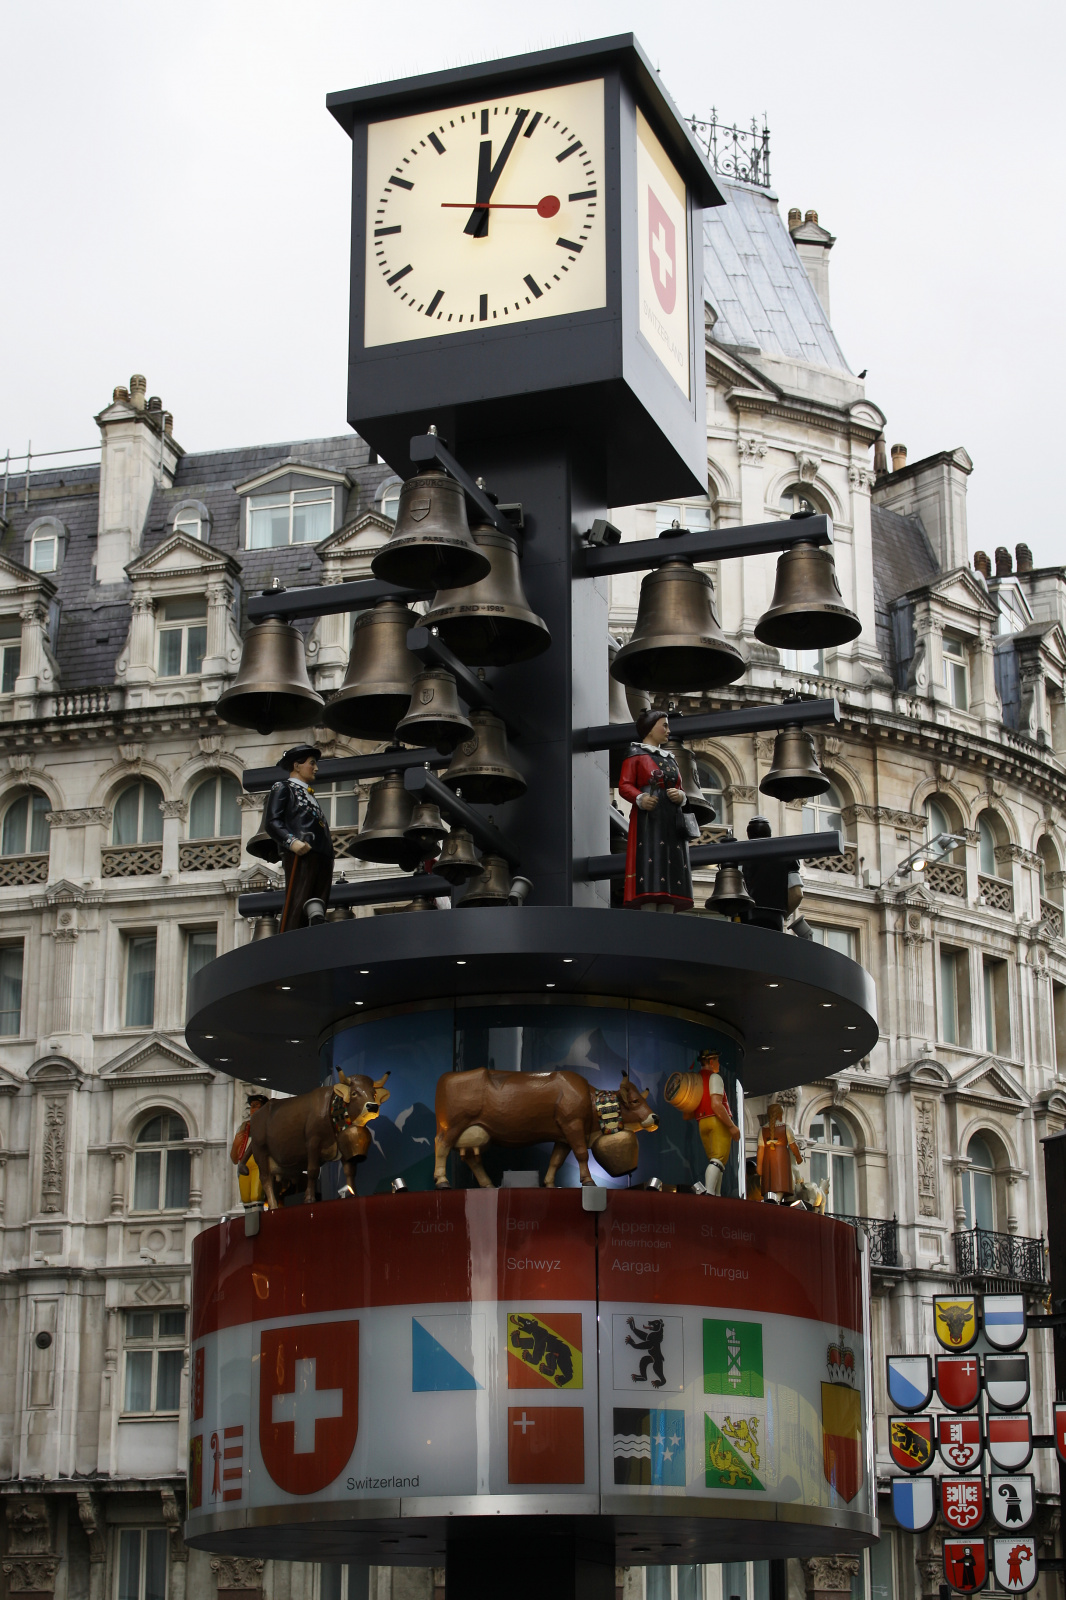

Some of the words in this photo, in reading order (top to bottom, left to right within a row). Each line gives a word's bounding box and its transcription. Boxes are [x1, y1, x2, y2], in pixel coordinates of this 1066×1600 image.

[642, 300, 684, 367] SWITZERLAND
[459, 605, 479, 613] END
[486, 605, 505, 613] 1985
[411, 1220, 454, 1234] Zürich
[506, 1218, 540, 1231] Bern
[610, 1220, 676, 1237] Appenzell
[700, 1224, 717, 1239] St.
[719, 1226, 757, 1243] Gallen
[610, 1237, 672, 1249] Innerrhoden
[506, 1257, 561, 1272] Schwyz
[611, 1259, 660, 1275] Aargau
[701, 1263, 750, 1281] Thurgau
[346, 1475, 420, 1491] Switzerland
